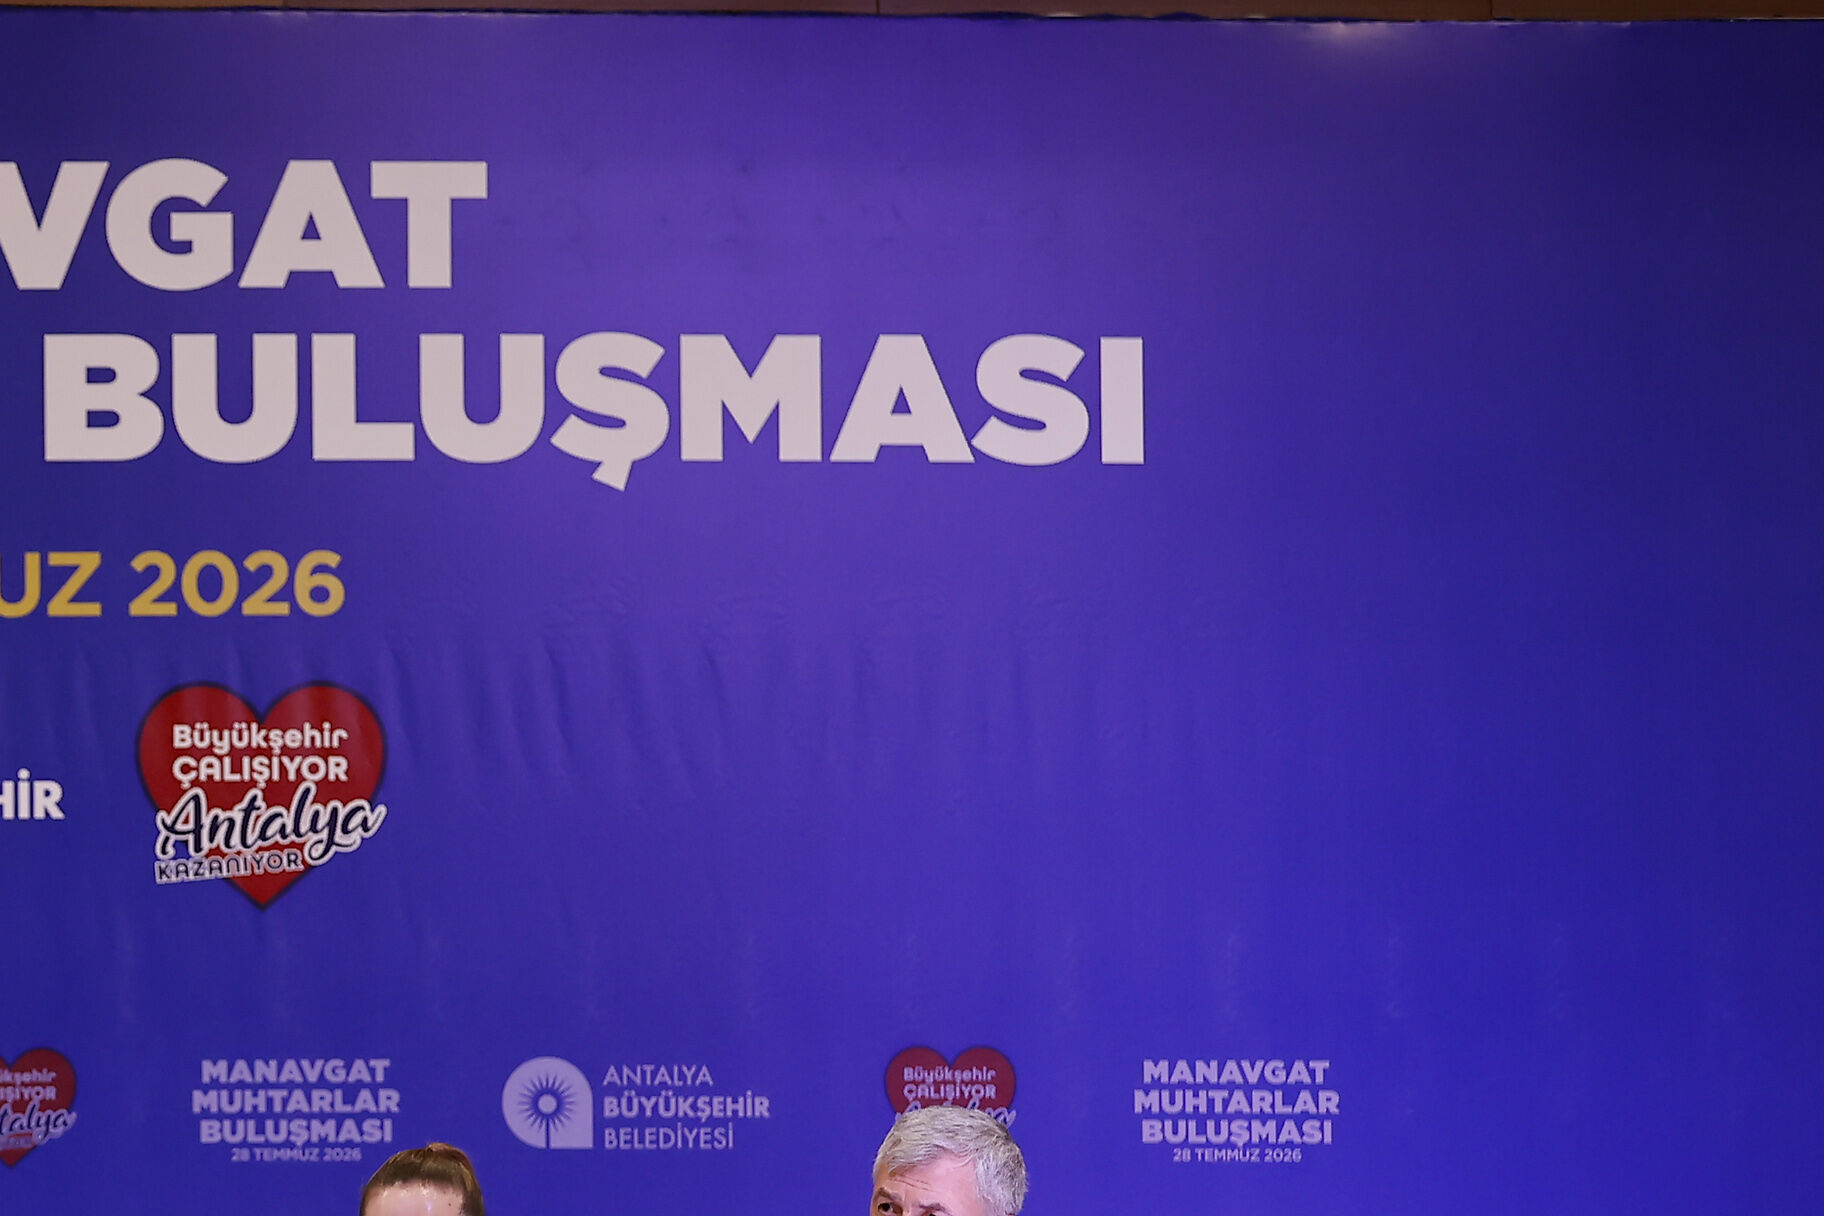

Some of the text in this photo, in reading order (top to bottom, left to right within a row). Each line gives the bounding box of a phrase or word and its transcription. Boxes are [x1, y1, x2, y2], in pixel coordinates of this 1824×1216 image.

[44, 332, 1144, 491] BULUŞMASI
[130, 550, 345, 616] 2026
[173, 721, 348, 754] Büyükşehir
[173, 755, 349, 789] ÇALIŞIYOR
[156, 781, 387, 866] Antalya
[155, 849, 304, 884] KAZANIYOR
[202, 1059, 390, 1083] MANAVGAT
[603, 1065, 713, 1086] ANTALYA
[1144, 1060, 1329, 1084] MANAVGAT
[192, 1089, 400, 1113] MUHTARLAR
[604, 1090, 769, 1122] BÜYÜKŞEHİR
[1134, 1089, 1339, 1114] MUHTARLAR
[200, 1119, 392, 1147] BULUŞMASI
[605, 1121, 733, 1149] BELEDİYESİ
[1142, 1119, 1331, 1147] BULUŞMASI
[1195, 1148, 1260, 1162] TEMMUZ
[1264, 1148, 1301, 1162] 2026
